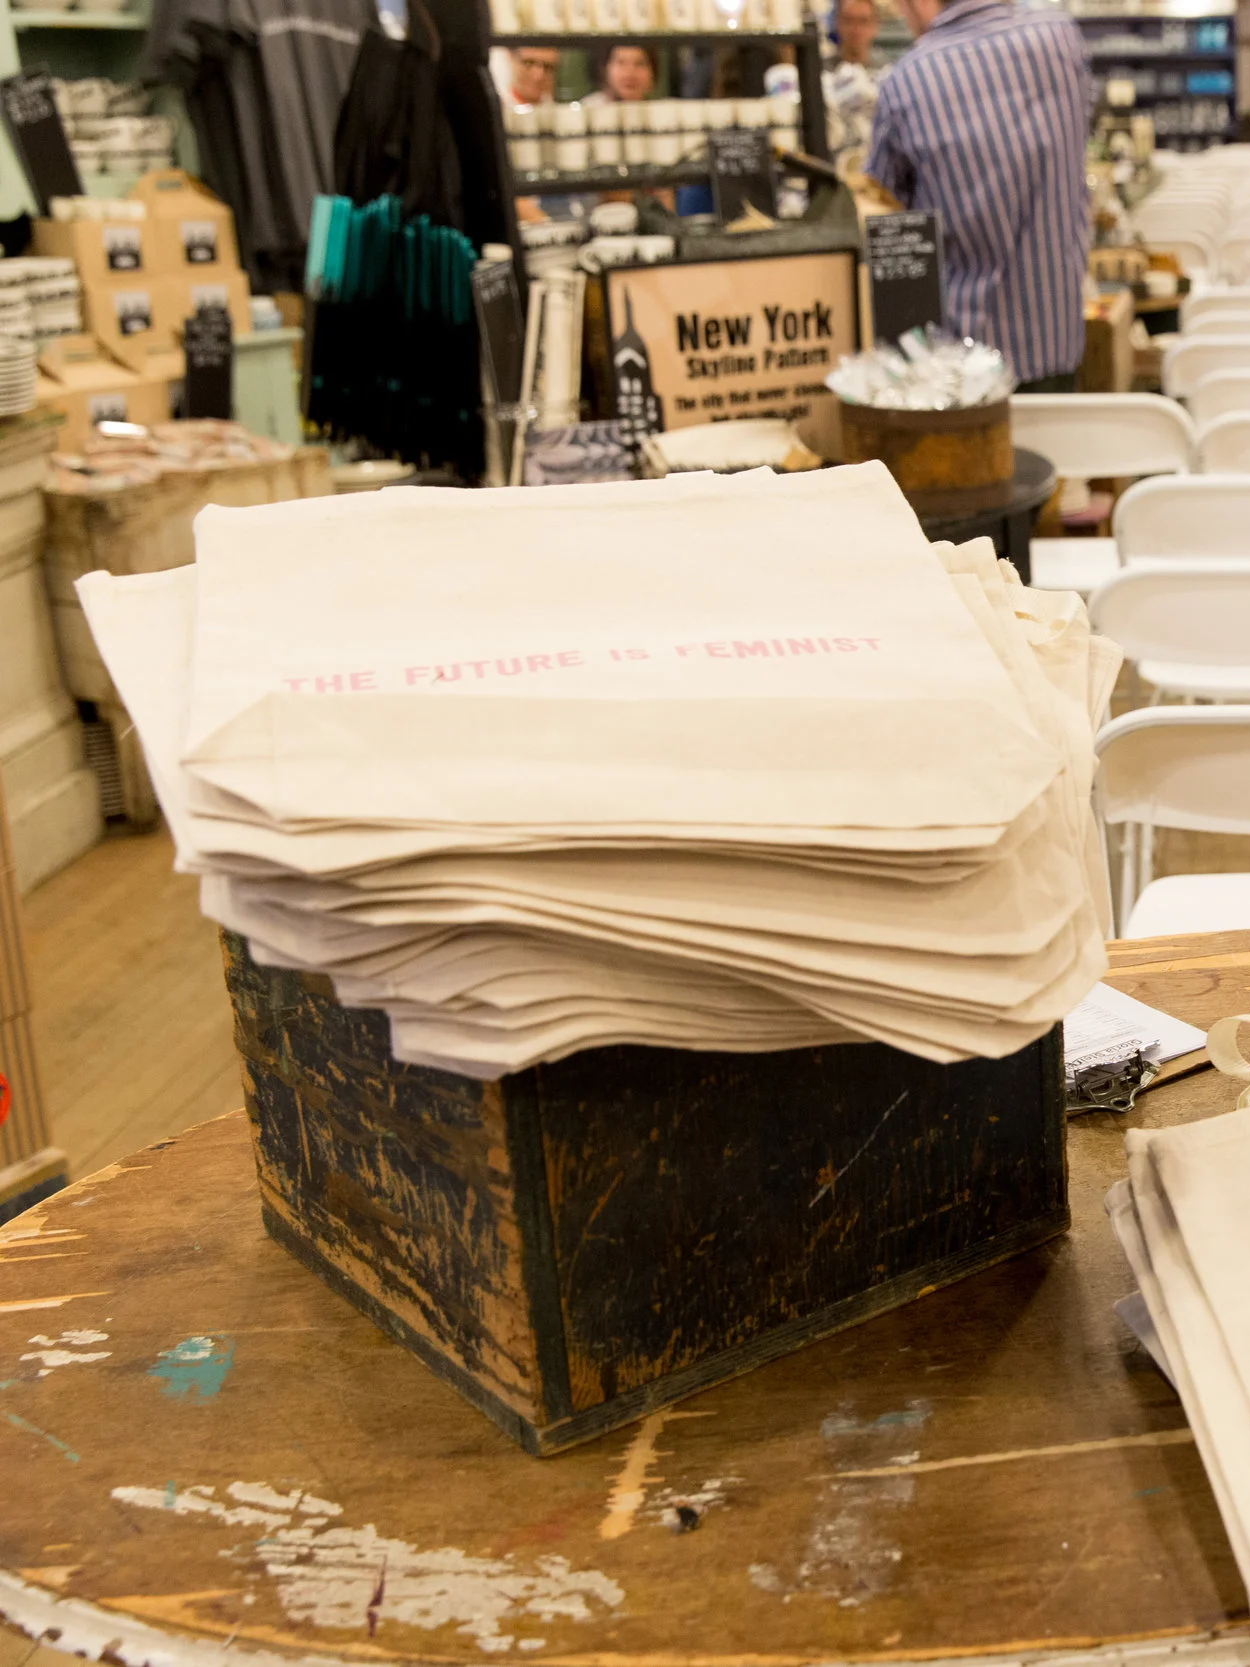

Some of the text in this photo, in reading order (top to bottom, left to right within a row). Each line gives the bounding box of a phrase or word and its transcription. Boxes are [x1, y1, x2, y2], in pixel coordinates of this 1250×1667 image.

[677, 300, 832, 352] New York
[687, 348, 829, 379] Skyline Pattern
[282, 636, 882, 696] THE FUTURE IS FEMINIST
